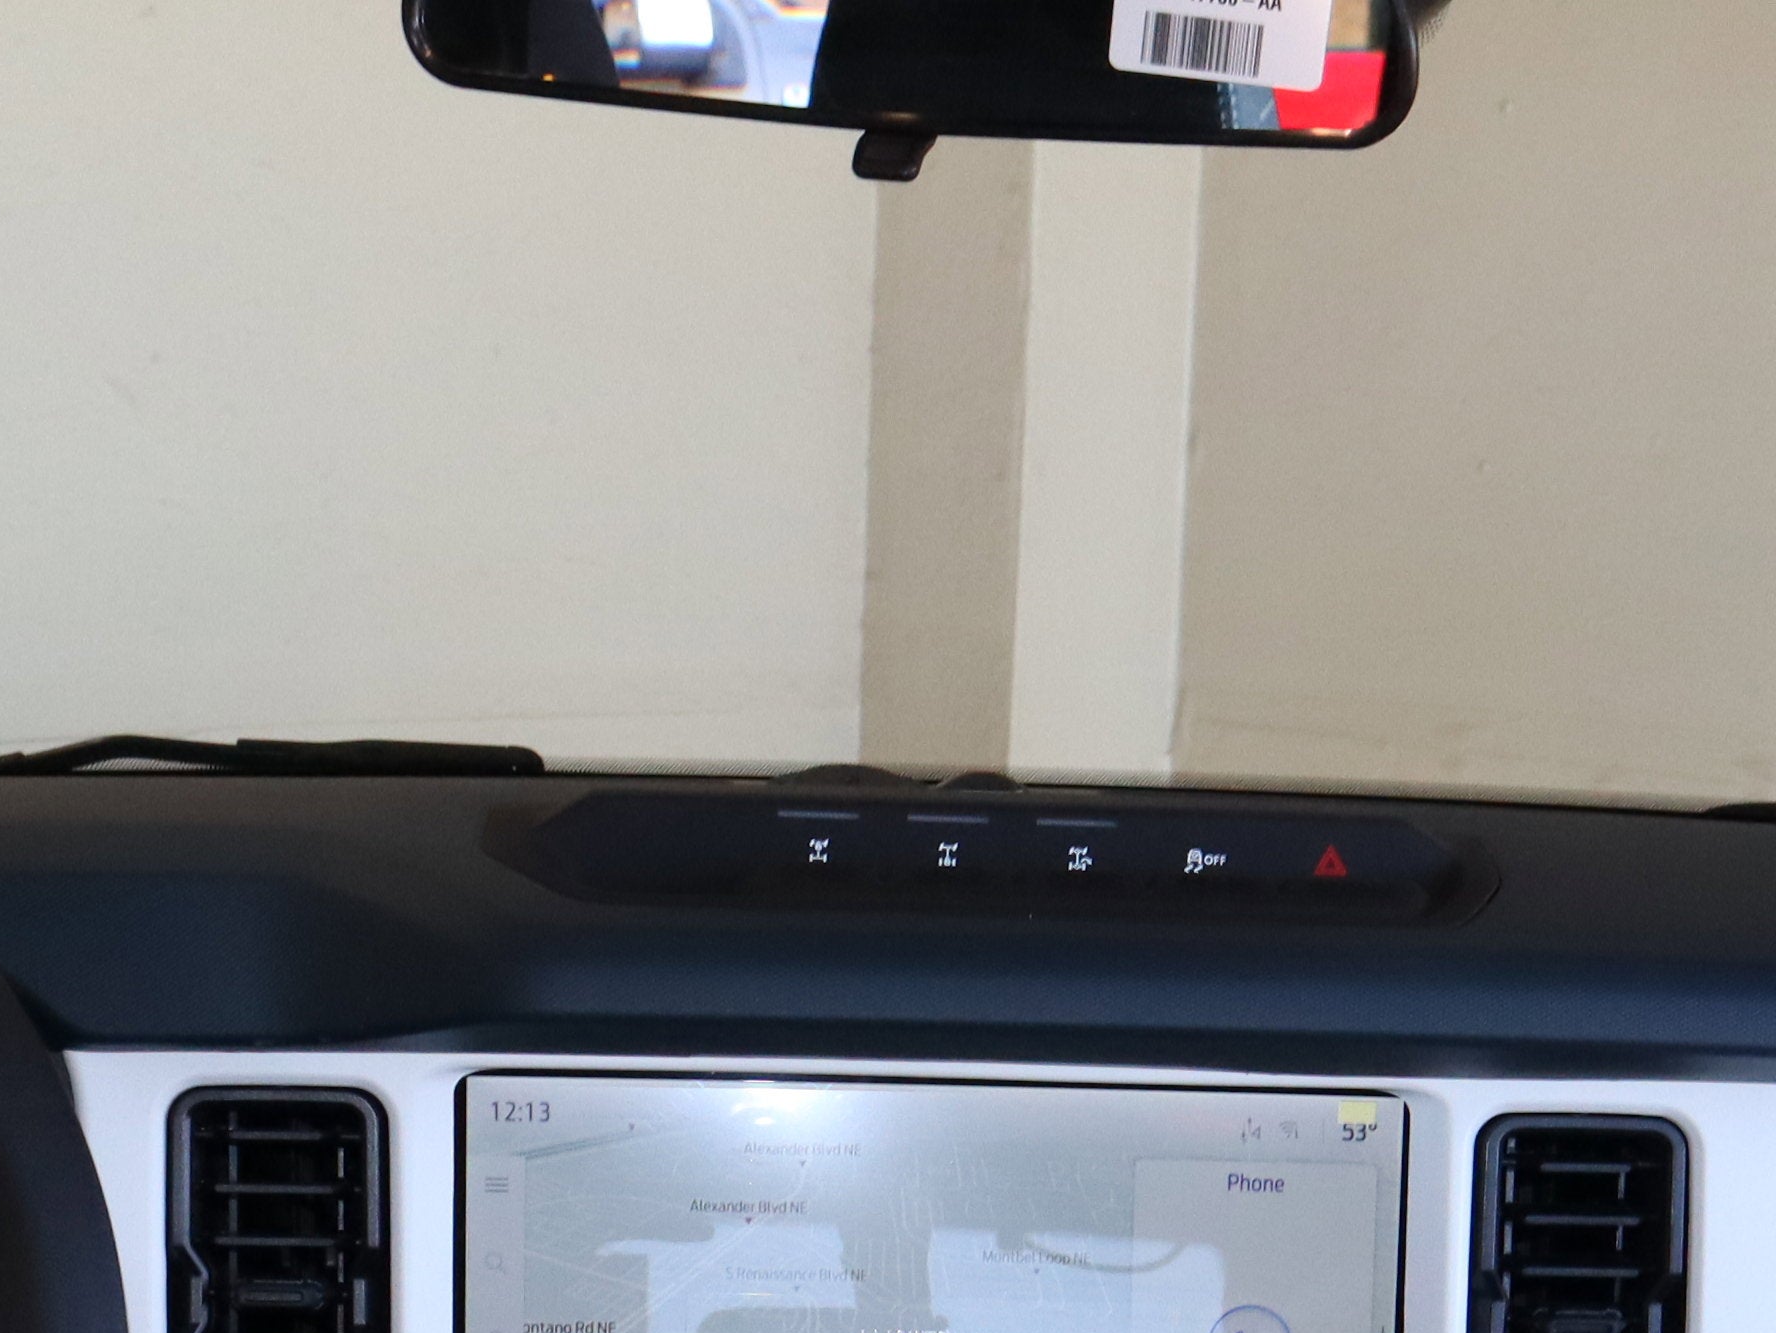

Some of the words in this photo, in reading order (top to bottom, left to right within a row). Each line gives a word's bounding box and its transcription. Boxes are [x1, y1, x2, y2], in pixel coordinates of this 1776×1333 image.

[1203, 854, 1227, 866] OFF
[490, 1101, 551, 1123] 12:13
[1227, 1173, 1285, 1193] Phone
[690, 1200, 756, 1214] Alexander
[758, 1201, 787, 1214] Blvd
[789, 1202, 808, 1215] NE
